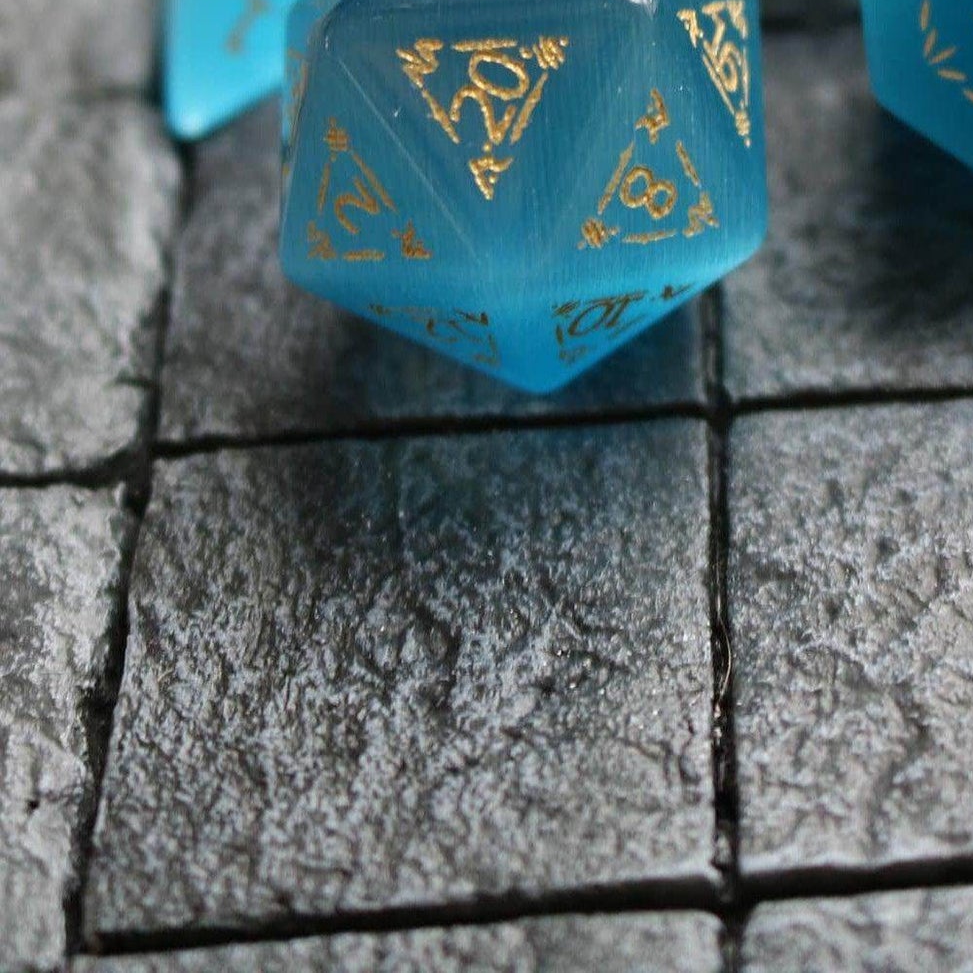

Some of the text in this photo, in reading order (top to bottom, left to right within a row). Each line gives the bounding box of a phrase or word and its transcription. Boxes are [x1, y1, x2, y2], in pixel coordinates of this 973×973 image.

[450, 48, 530, 145] 20
[333, 175, 379, 234] 2
[619, 165, 678, 220] 8
